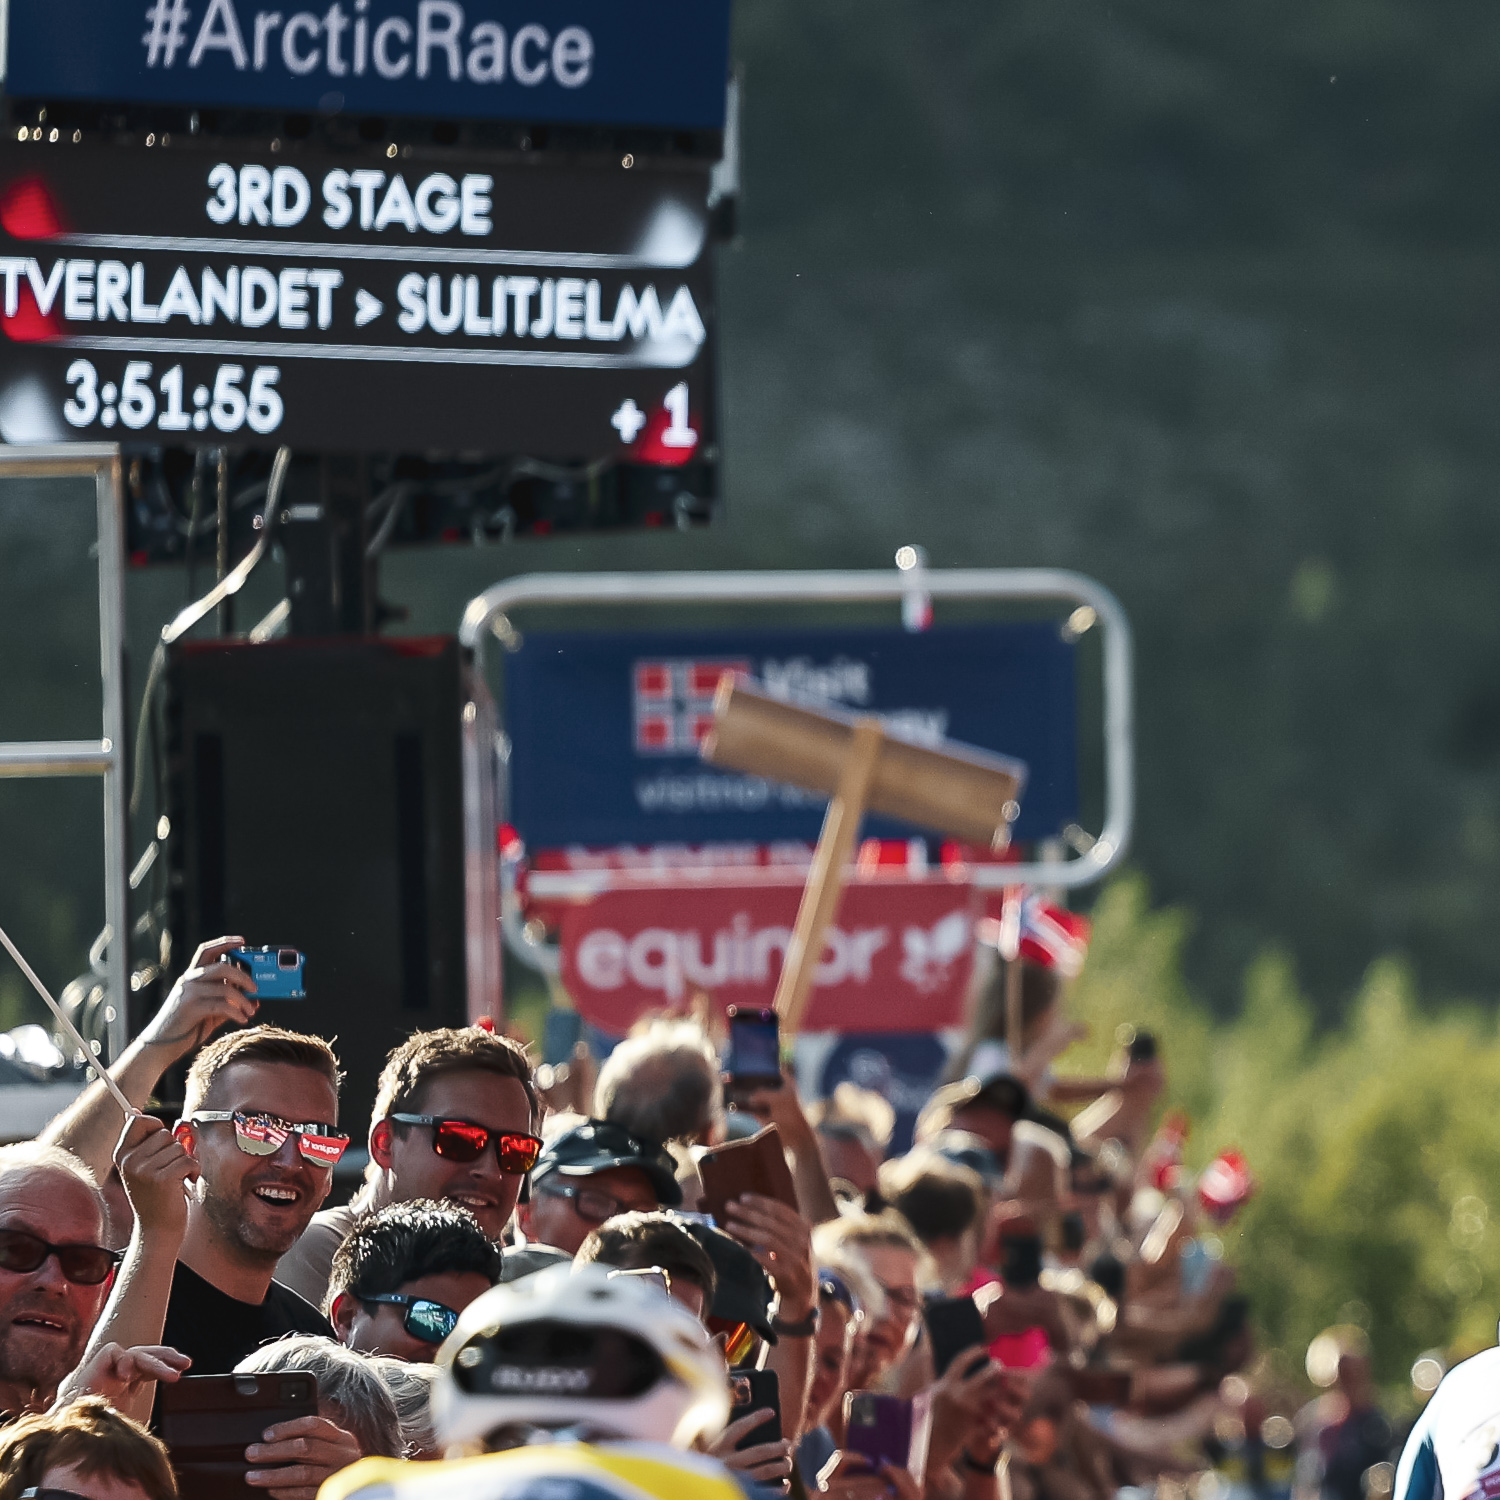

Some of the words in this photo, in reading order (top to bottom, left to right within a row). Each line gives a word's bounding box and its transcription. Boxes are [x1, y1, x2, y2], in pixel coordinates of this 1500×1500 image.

[142, 0, 594, 88] #ArcticRace
[205, 163, 311, 229] 3RD
[321, 169, 494, 236] STAGE
[0, 257, 343, 331] TVERLANDET
[397, 274, 706, 344] SULITJELMA
[64, 359, 285, 435] 3:51:55
